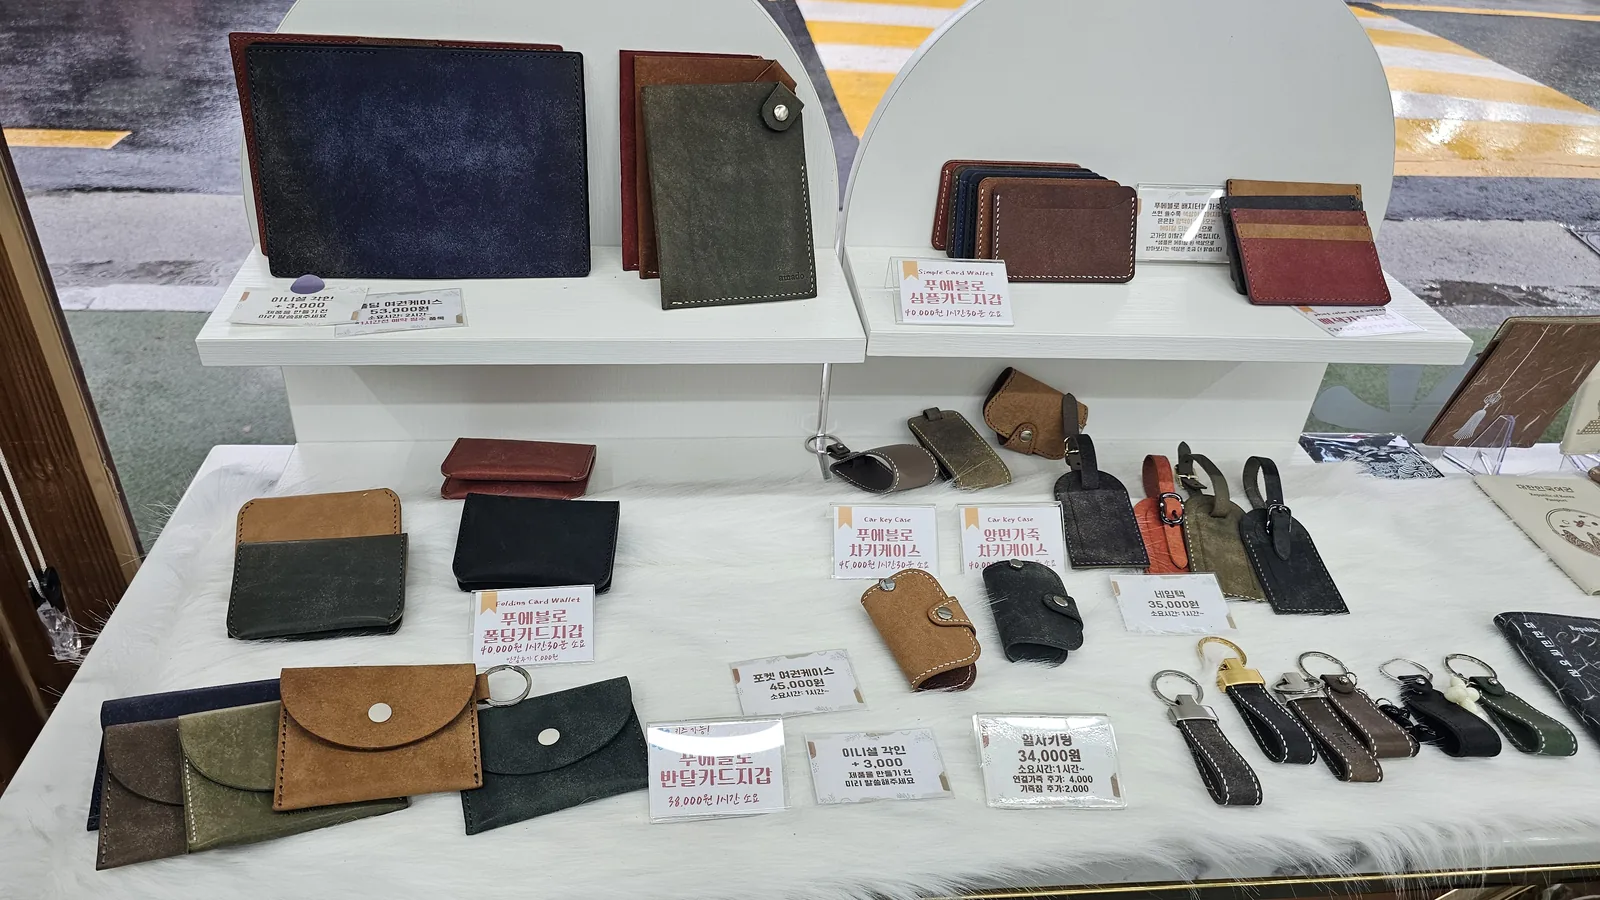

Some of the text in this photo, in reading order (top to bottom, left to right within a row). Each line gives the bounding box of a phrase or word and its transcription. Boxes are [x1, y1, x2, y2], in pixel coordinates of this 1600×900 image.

[918, 268, 942, 276] Simple
[924, 279, 986, 291] 푸에블로
[910, 292, 1003, 306] 심플카드지갑
[879, 516, 893, 524] Key
[1002, 516, 1016, 524] Key
[856, 528, 914, 542] 푸에블로
[984, 527, 1040, 542] 양면가죽
[849, 543, 922, 557] 차키케이스
[977, 543, 1049, 557] 차키케이스
[1154, 590, 1186, 599] 네임택
[1148, 600, 1201, 609] 35,000원
[501, 609, 567, 626] 푸에블로
[484, 624, 585, 644] 폴딩카드지갑
[753, 666, 835, 683] 포켓 여권케이스
[769, 678, 825, 691] 45,000원
[842, 745, 907, 758] 이니셜 각인
[1017, 748, 1082, 763] 34,000원
[863, 757, 904, 769] 3,000
[660, 767, 773, 788] 반달카드지갑
[848, 768, 912, 779] 제품을 만들기 전
[1012, 775, 1043, 784] 연결가죽
[845, 776, 916, 788] 미리 말씀해주세요
[668, 792, 760, 808] 38,000원 1시간 소요
